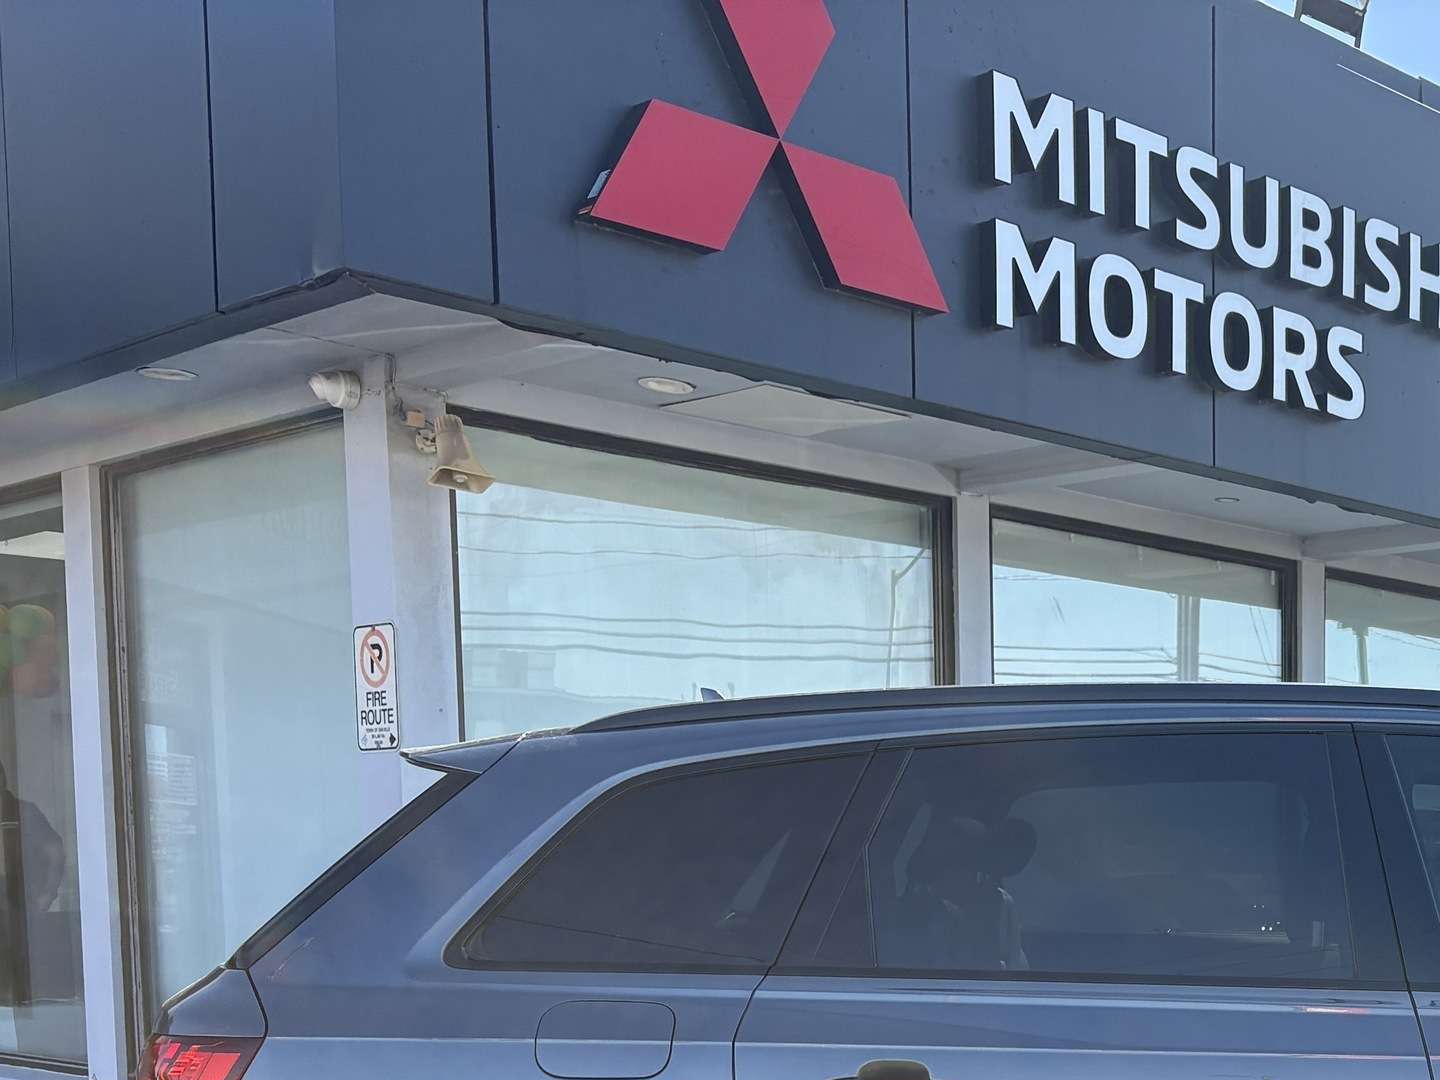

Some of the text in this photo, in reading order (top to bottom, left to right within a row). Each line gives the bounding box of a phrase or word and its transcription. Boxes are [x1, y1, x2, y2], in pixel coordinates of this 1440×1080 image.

[995, 218, 1366, 421] MOTORS
[366, 690, 387, 707] FIRE
[361, 708, 395, 726] ROUTE
